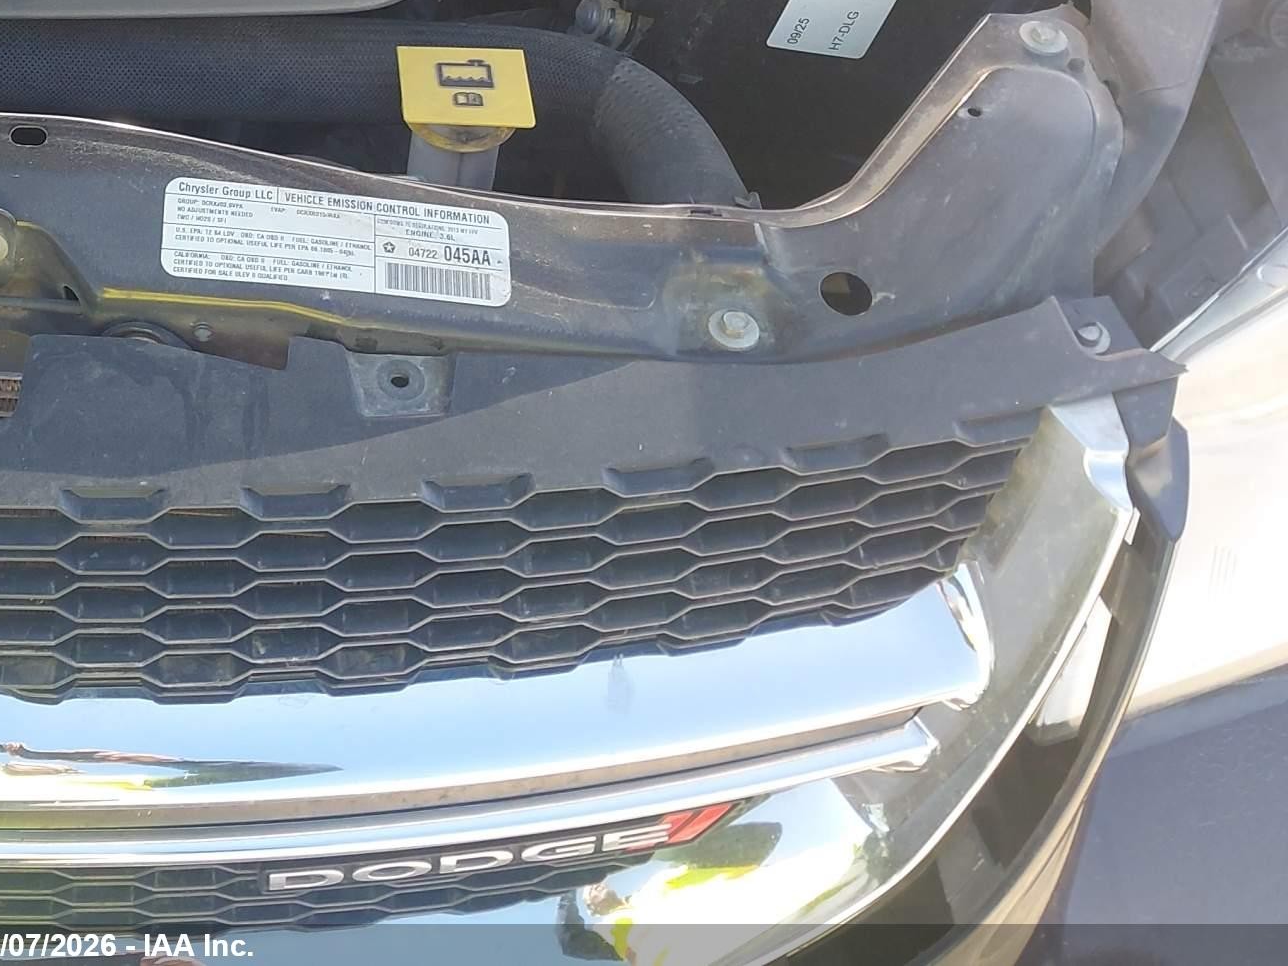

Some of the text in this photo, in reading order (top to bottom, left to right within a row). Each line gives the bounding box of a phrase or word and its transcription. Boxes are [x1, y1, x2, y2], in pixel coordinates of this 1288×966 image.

[787, 18, 810, 45] 09/25
[829, 11, 859, 51] H7-DLG
[178, 181, 273, 200] Chrysler Group LLC
[187, 207, 229, 215] ADJUSTMENTS
[285, 192, 490, 225] VEHICLE EMISSION CONTROL INFORMATION
[175, 234, 205, 242] CERTIFIED
[216, 237, 244, 245] OPTIONAL
[311, 238, 338, 246] GASOLINE
[440, 233, 456, 241] 3.6L
[408, 245, 491, 266] 04722 045AA
[172, 266, 203, 274] CERTIFIED
[173, 258, 203, 266] CERTIFIED
[214, 262, 243, 270] OPTIONAL
[245, 264, 268, 272] USEFUL
[268, 821, 674, 891] DODGE
